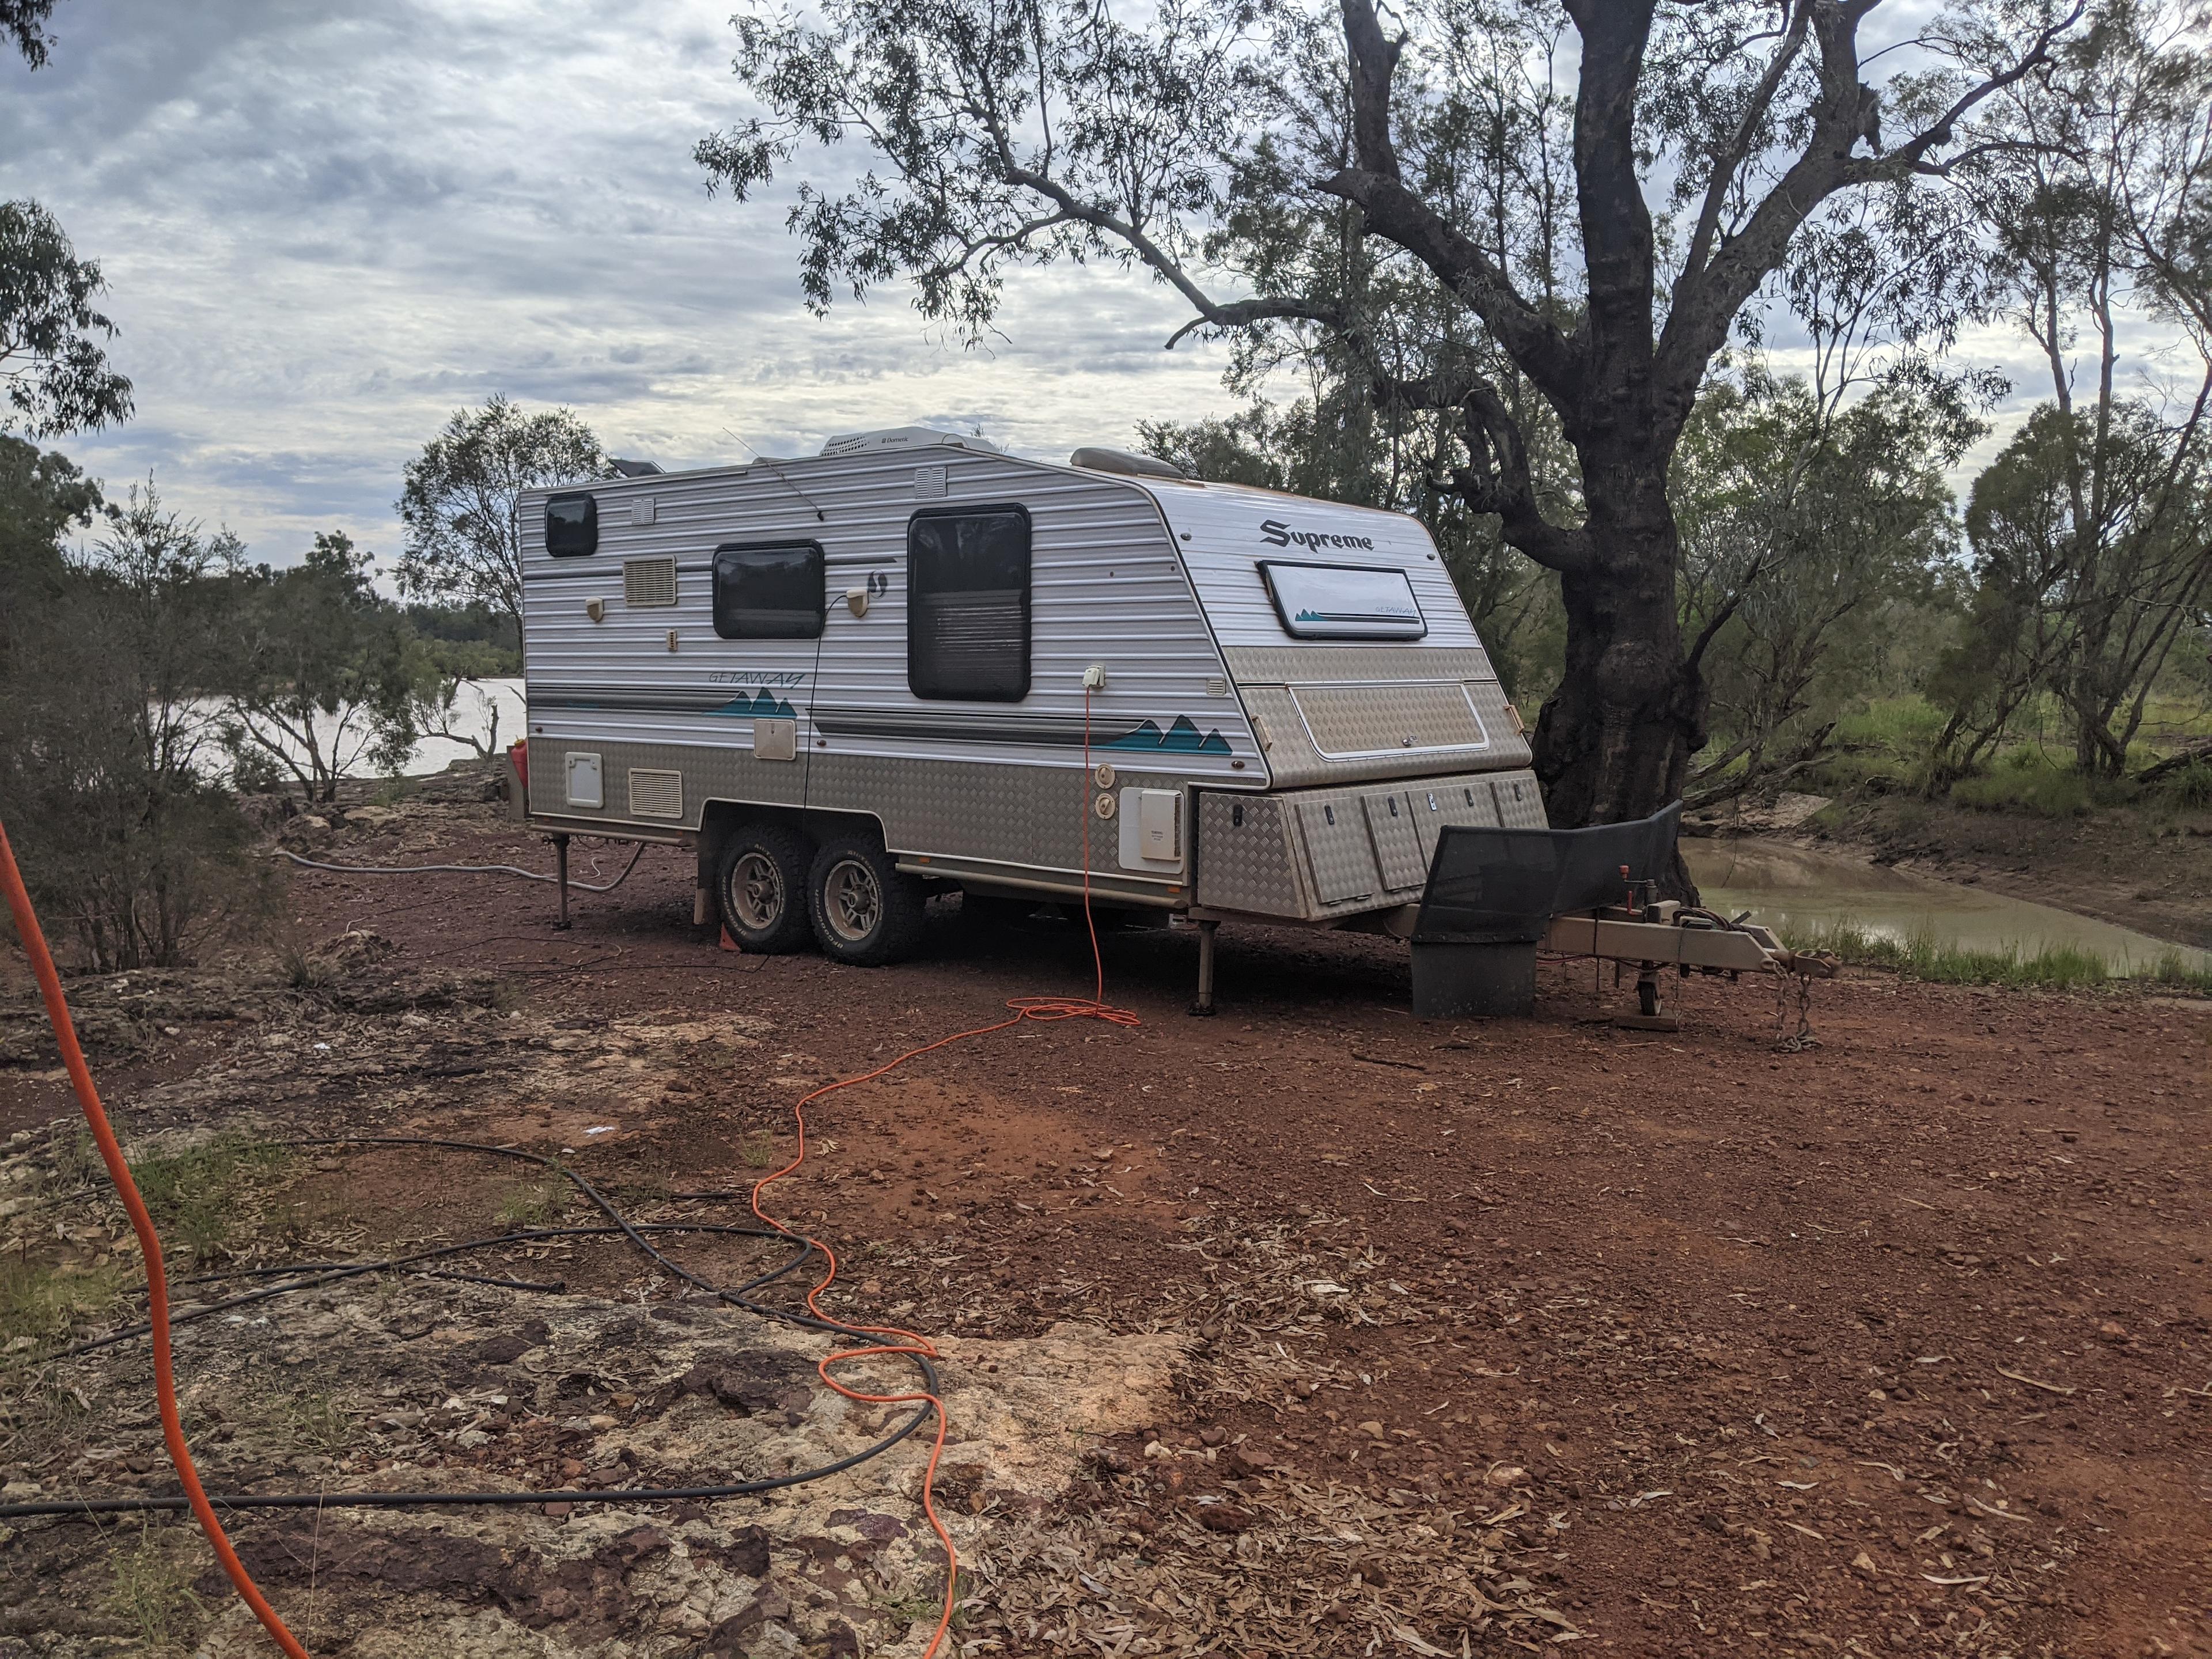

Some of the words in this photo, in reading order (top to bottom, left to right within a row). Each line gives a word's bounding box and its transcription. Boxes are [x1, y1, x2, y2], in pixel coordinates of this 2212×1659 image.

[1260, 519, 1374, 554] Supreme
[1375, 606, 1416, 618] GETAWAY
[709, 672, 806, 690] GETAWAY
